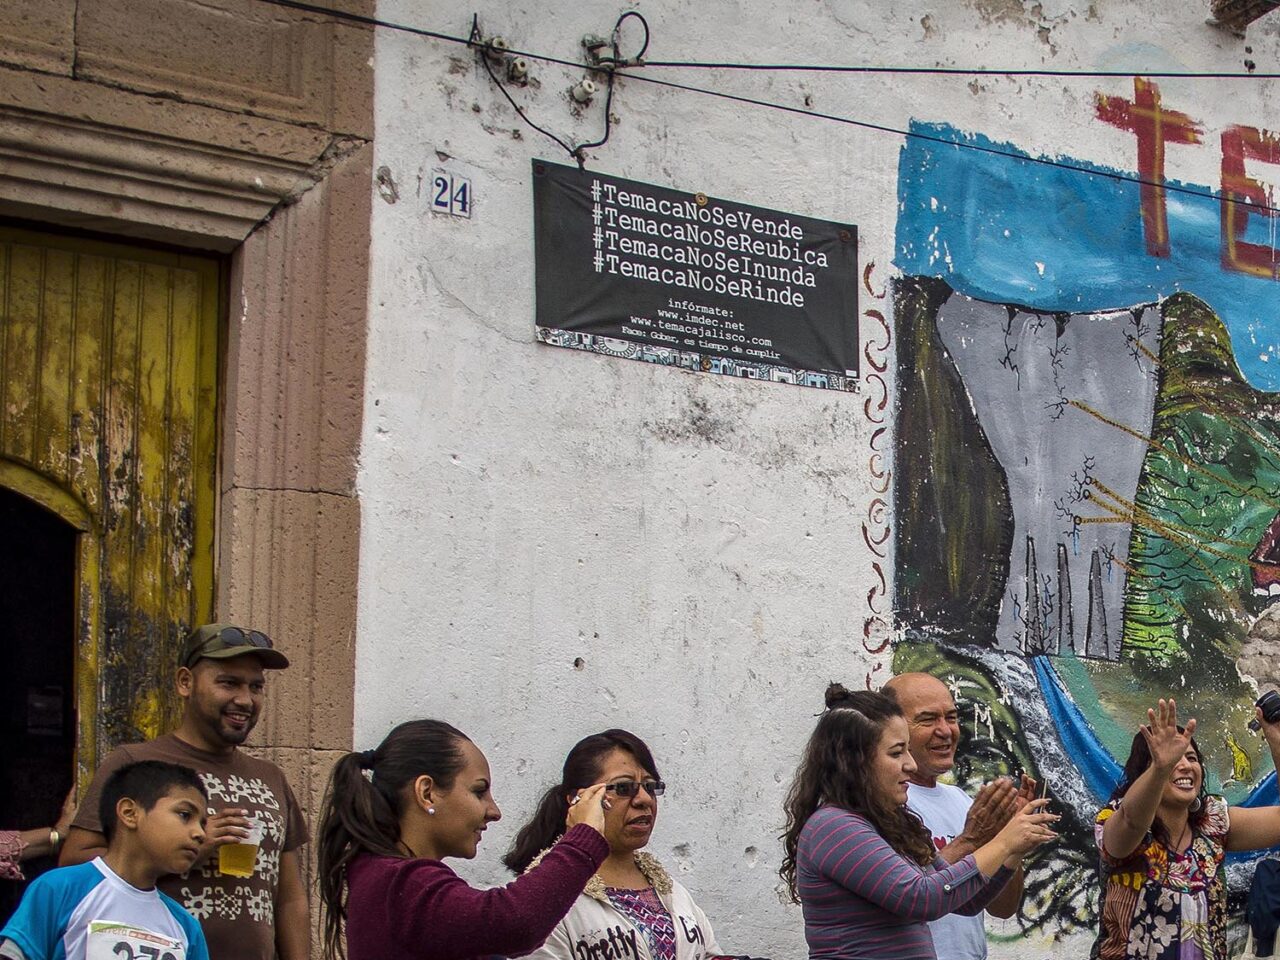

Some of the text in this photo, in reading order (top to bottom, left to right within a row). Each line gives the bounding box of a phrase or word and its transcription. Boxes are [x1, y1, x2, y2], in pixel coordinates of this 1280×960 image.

[434, 176, 468, 213] 24
[590, 179, 804, 241] #TemacaNoSeVende
[591, 203, 829, 268] #TemacaNoSeReubica
[592, 226, 817, 288] #TemacaNoSeInunda
[593, 250, 805, 308] #TemacaNoSeRinde
[657, 309, 745, 331] www.imdec.net
[668, 297, 734, 318] infórmate:
[621, 325, 647, 338] Face:
[683, 337, 696, 346] es
[699, 339, 729, 352] tiempo
[731, 344, 743, 354] de
[630, 315, 773, 347] www.temacajalisco.com
